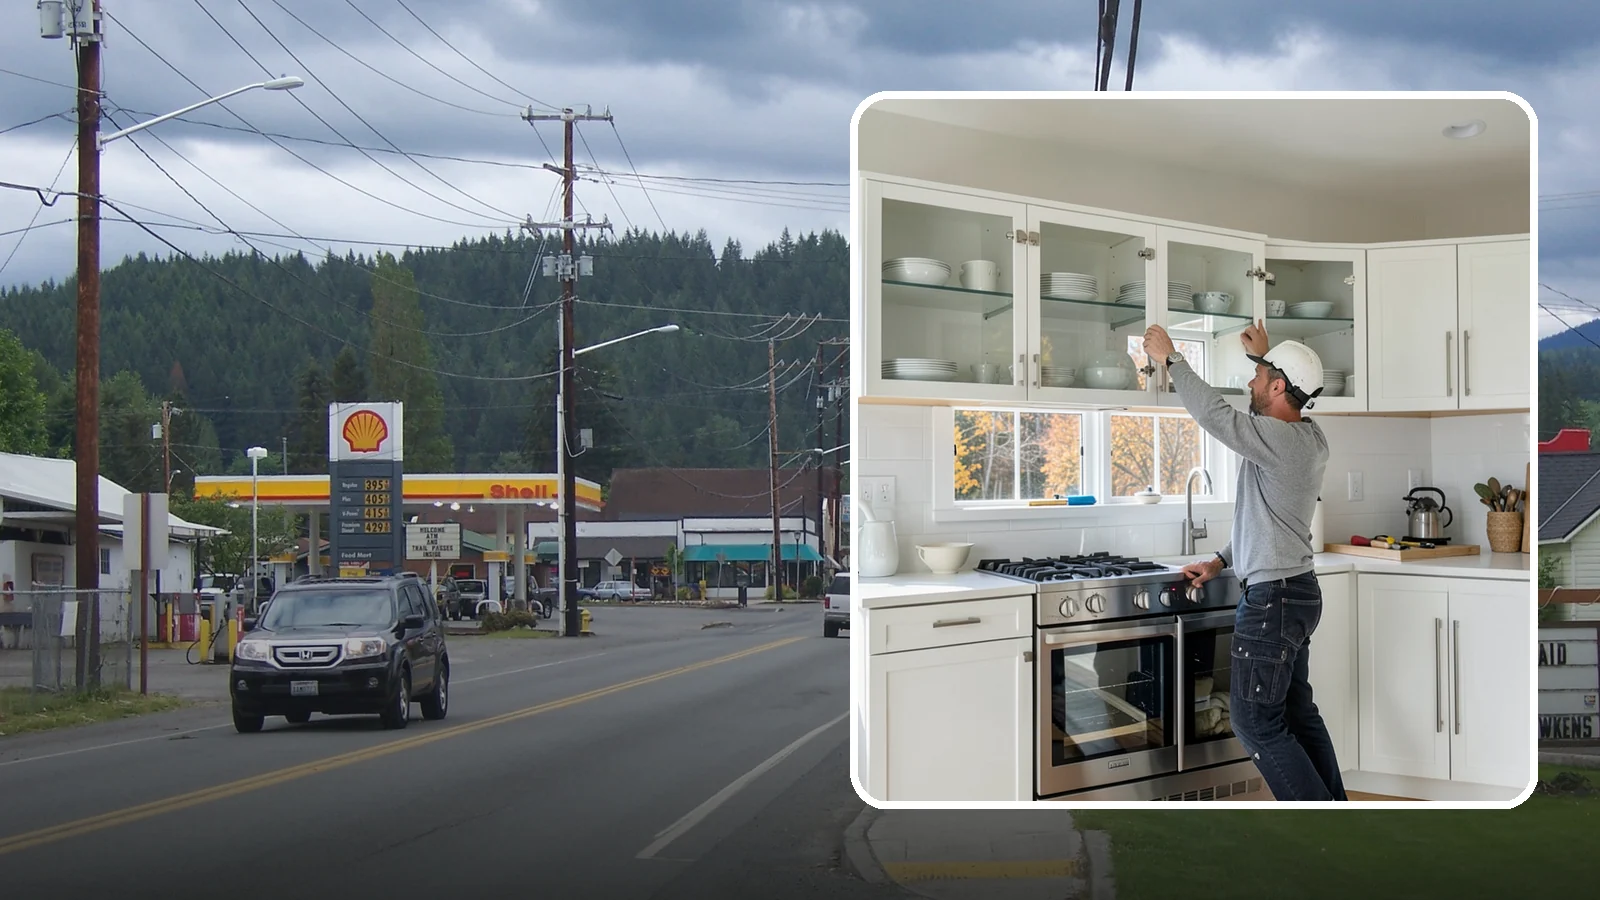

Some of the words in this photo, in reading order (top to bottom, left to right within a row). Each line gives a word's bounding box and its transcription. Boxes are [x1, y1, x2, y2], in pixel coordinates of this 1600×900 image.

[366, 480, 383, 490] 395
[490, 484, 547, 499] Shell
[366, 494, 383, 504] 405
[366, 508, 383, 518] 415
[366, 522, 383, 533] 429
